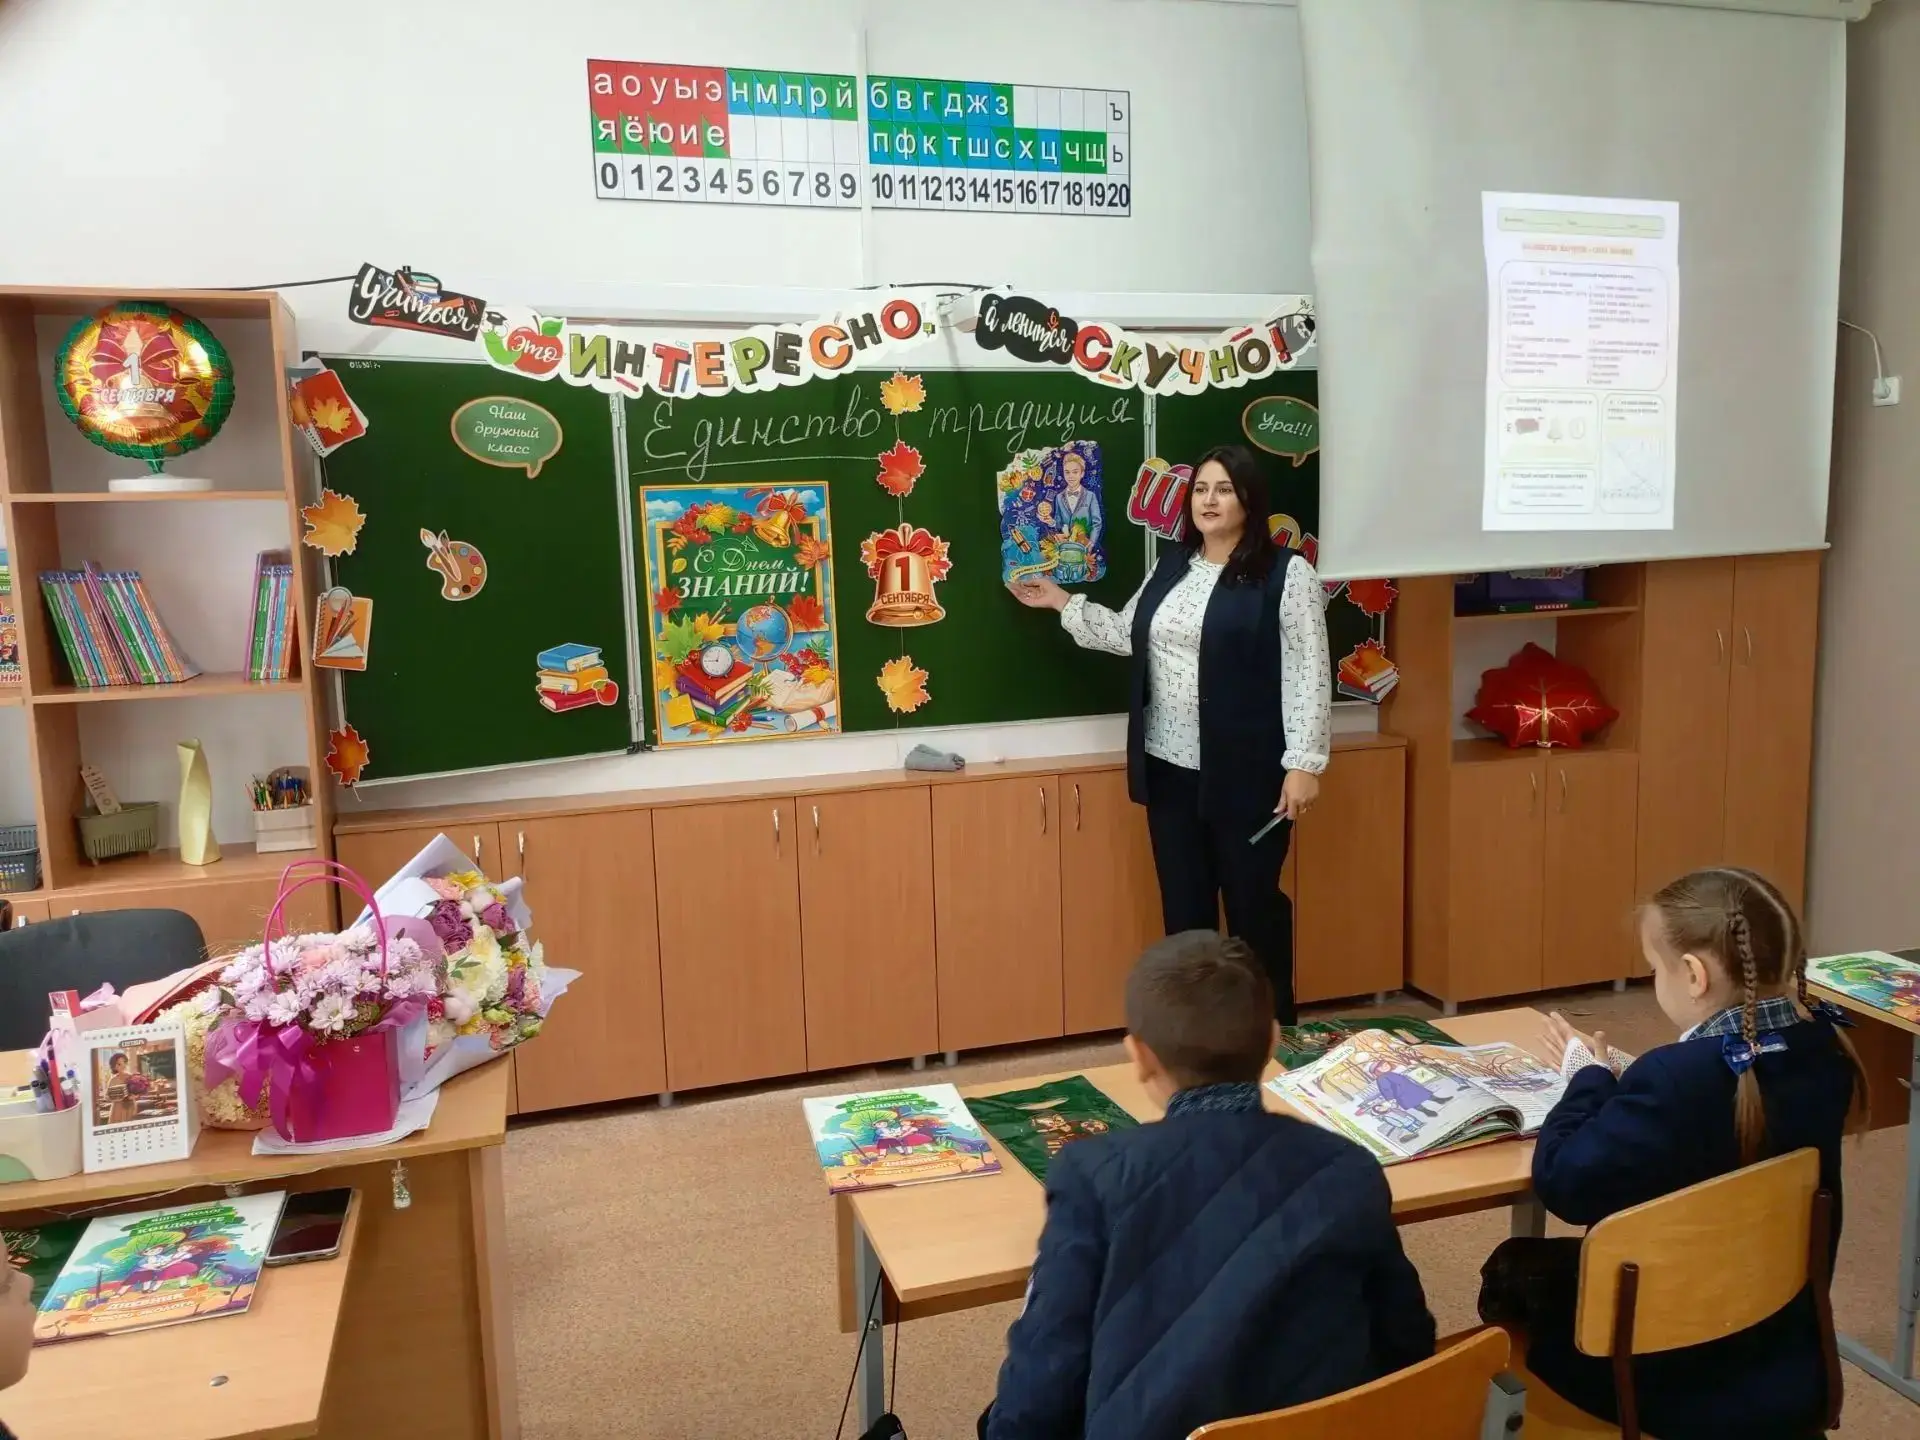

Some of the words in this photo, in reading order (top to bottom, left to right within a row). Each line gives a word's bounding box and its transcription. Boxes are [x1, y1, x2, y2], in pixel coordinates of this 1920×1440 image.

[601, 162, 618, 190] 0
[631, 163, 644, 191] 1
[656, 165, 674, 192] 2
[683, 166, 700, 193] 3
[709, 167, 728, 194] 4
[736, 169, 754, 195] 5
[762, 170, 780, 196] 6
[788, 171, 805, 197] 7
[814, 172, 831, 198] 8
[839, 172, 857, 199] 9
[872, 173, 893, 199] 10
[898, 174, 916, 200] 11
[921, 175, 942, 201] 12
[945, 176, 966, 202] 13
[968, 177, 990, 203] 14
[993, 178, 1014, 204] 15
[1016, 179, 1037, 204] 16
[1040, 180, 1060, 205] 17
[1063, 181, 1083, 206] 18
[1086, 182, 1106, 207] 19
[1107, 183, 1129, 208] 20
[122, 353, 141, 385] 1
[1074, 325, 1292, 389] СКУЧНО!
[100, 387, 177, 404] СЕНТЯБРЯ
[489, 404, 527, 421] Наш
[1258, 412, 1313, 437] Ура!!!
[474, 420, 540, 439] дружный
[644, 385, 881, 482] Единство
[928, 396, 1135, 463] традиция
[487, 443, 530, 454] класс
[693, 549, 715, 574] С
[717, 547, 785, 573] Днем
[895, 555, 911, 592] 1
[677, 566, 812, 599] ЗНАНИЙ!
[881, 592, 930, 605] СЕНТЯБРЯ
